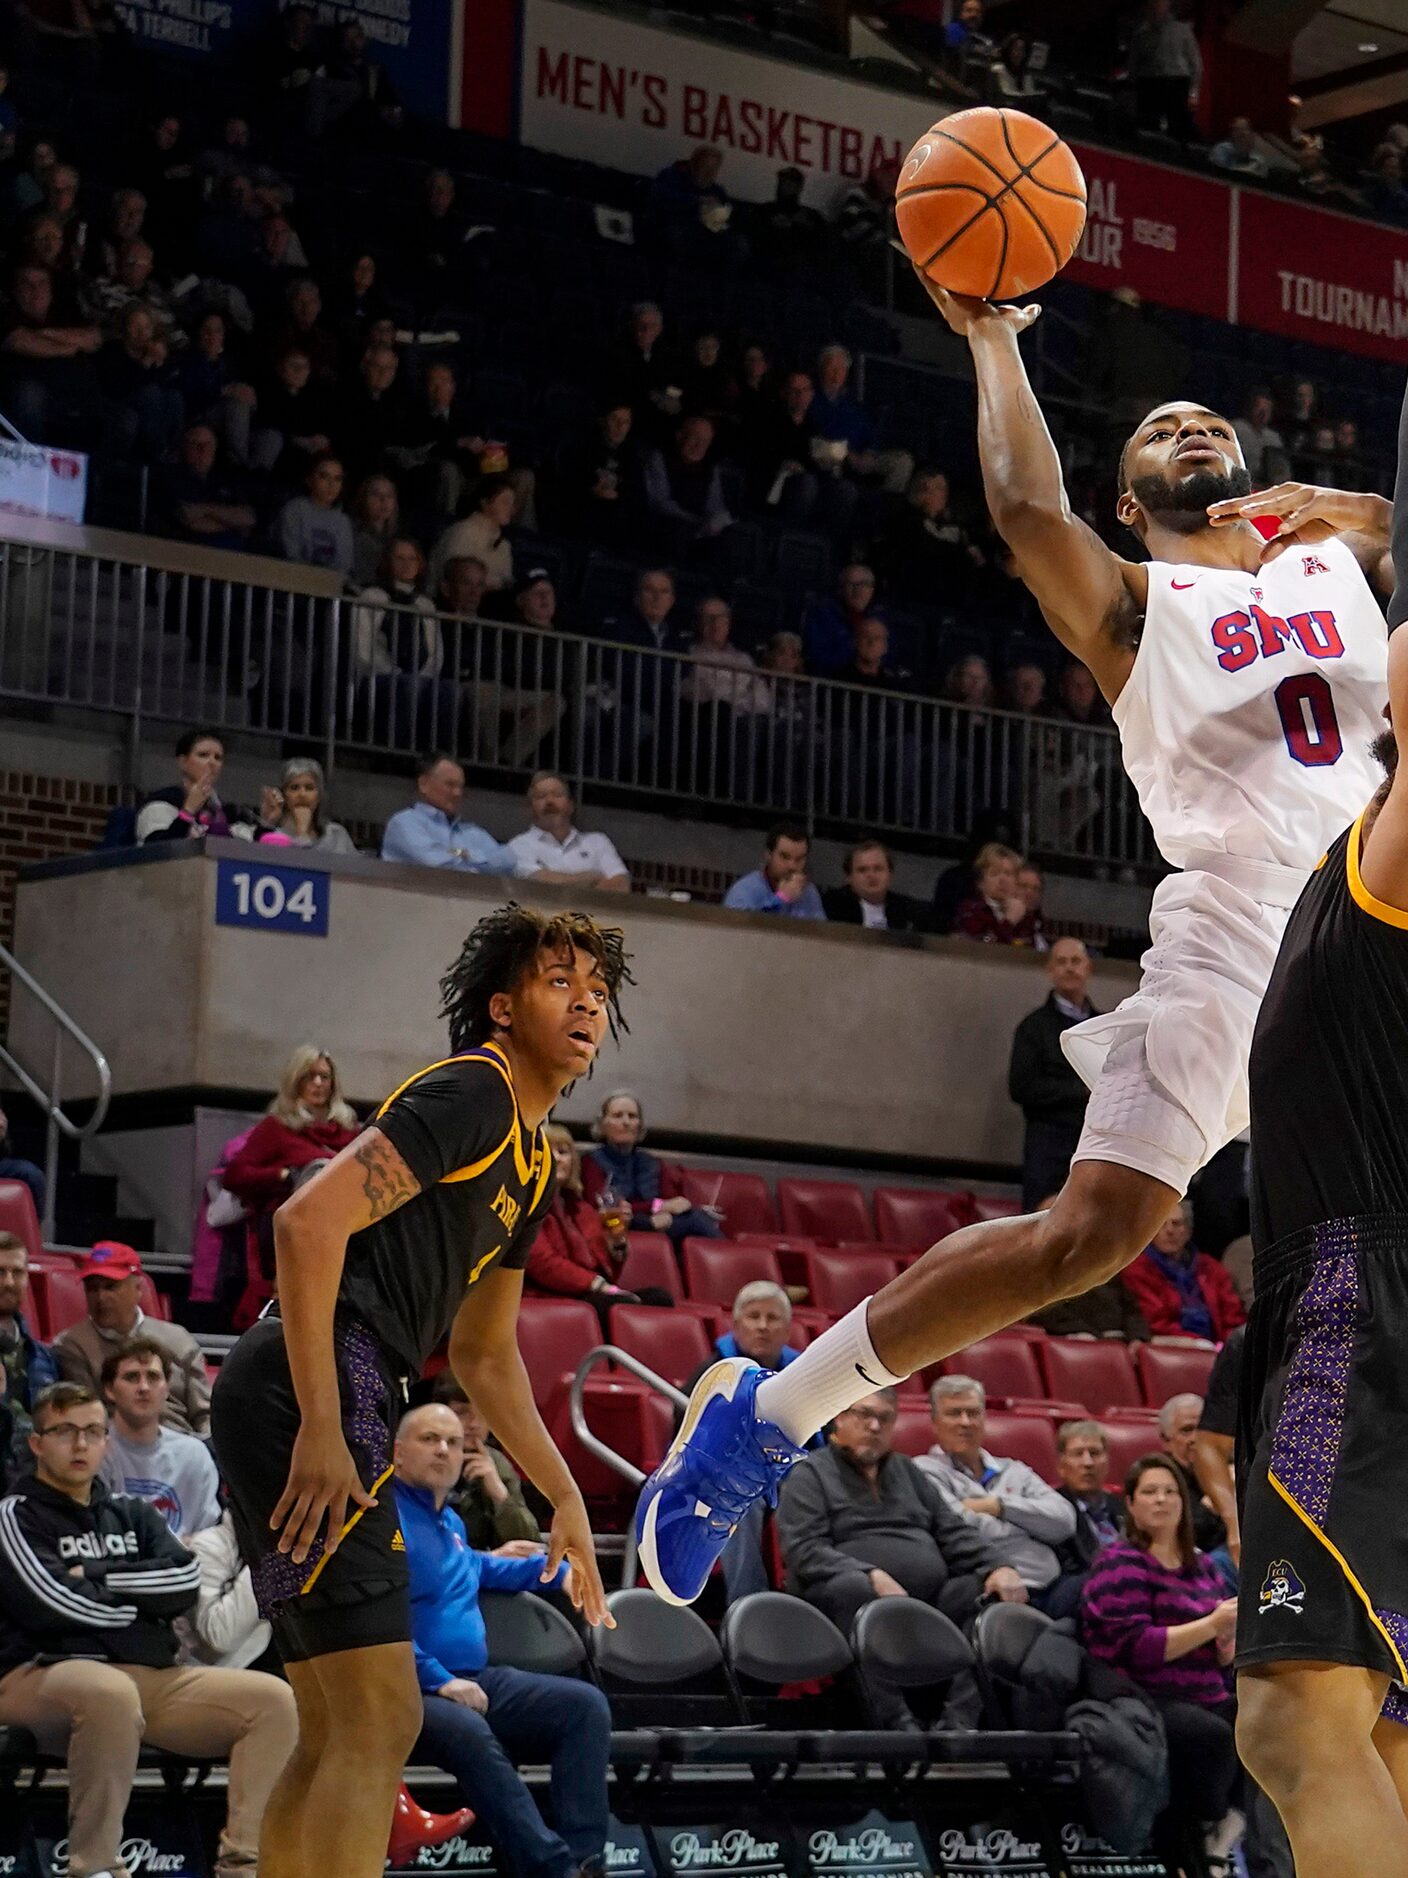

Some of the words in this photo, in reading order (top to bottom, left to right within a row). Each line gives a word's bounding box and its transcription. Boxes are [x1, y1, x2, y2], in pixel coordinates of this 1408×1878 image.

[537, 47, 668, 129] MEN'S
[683, 86, 901, 180] BASKETBA
[1211, 604, 1345, 673] SMU
[1274, 672, 1344, 768] 0
[232, 872, 317, 922] 104
